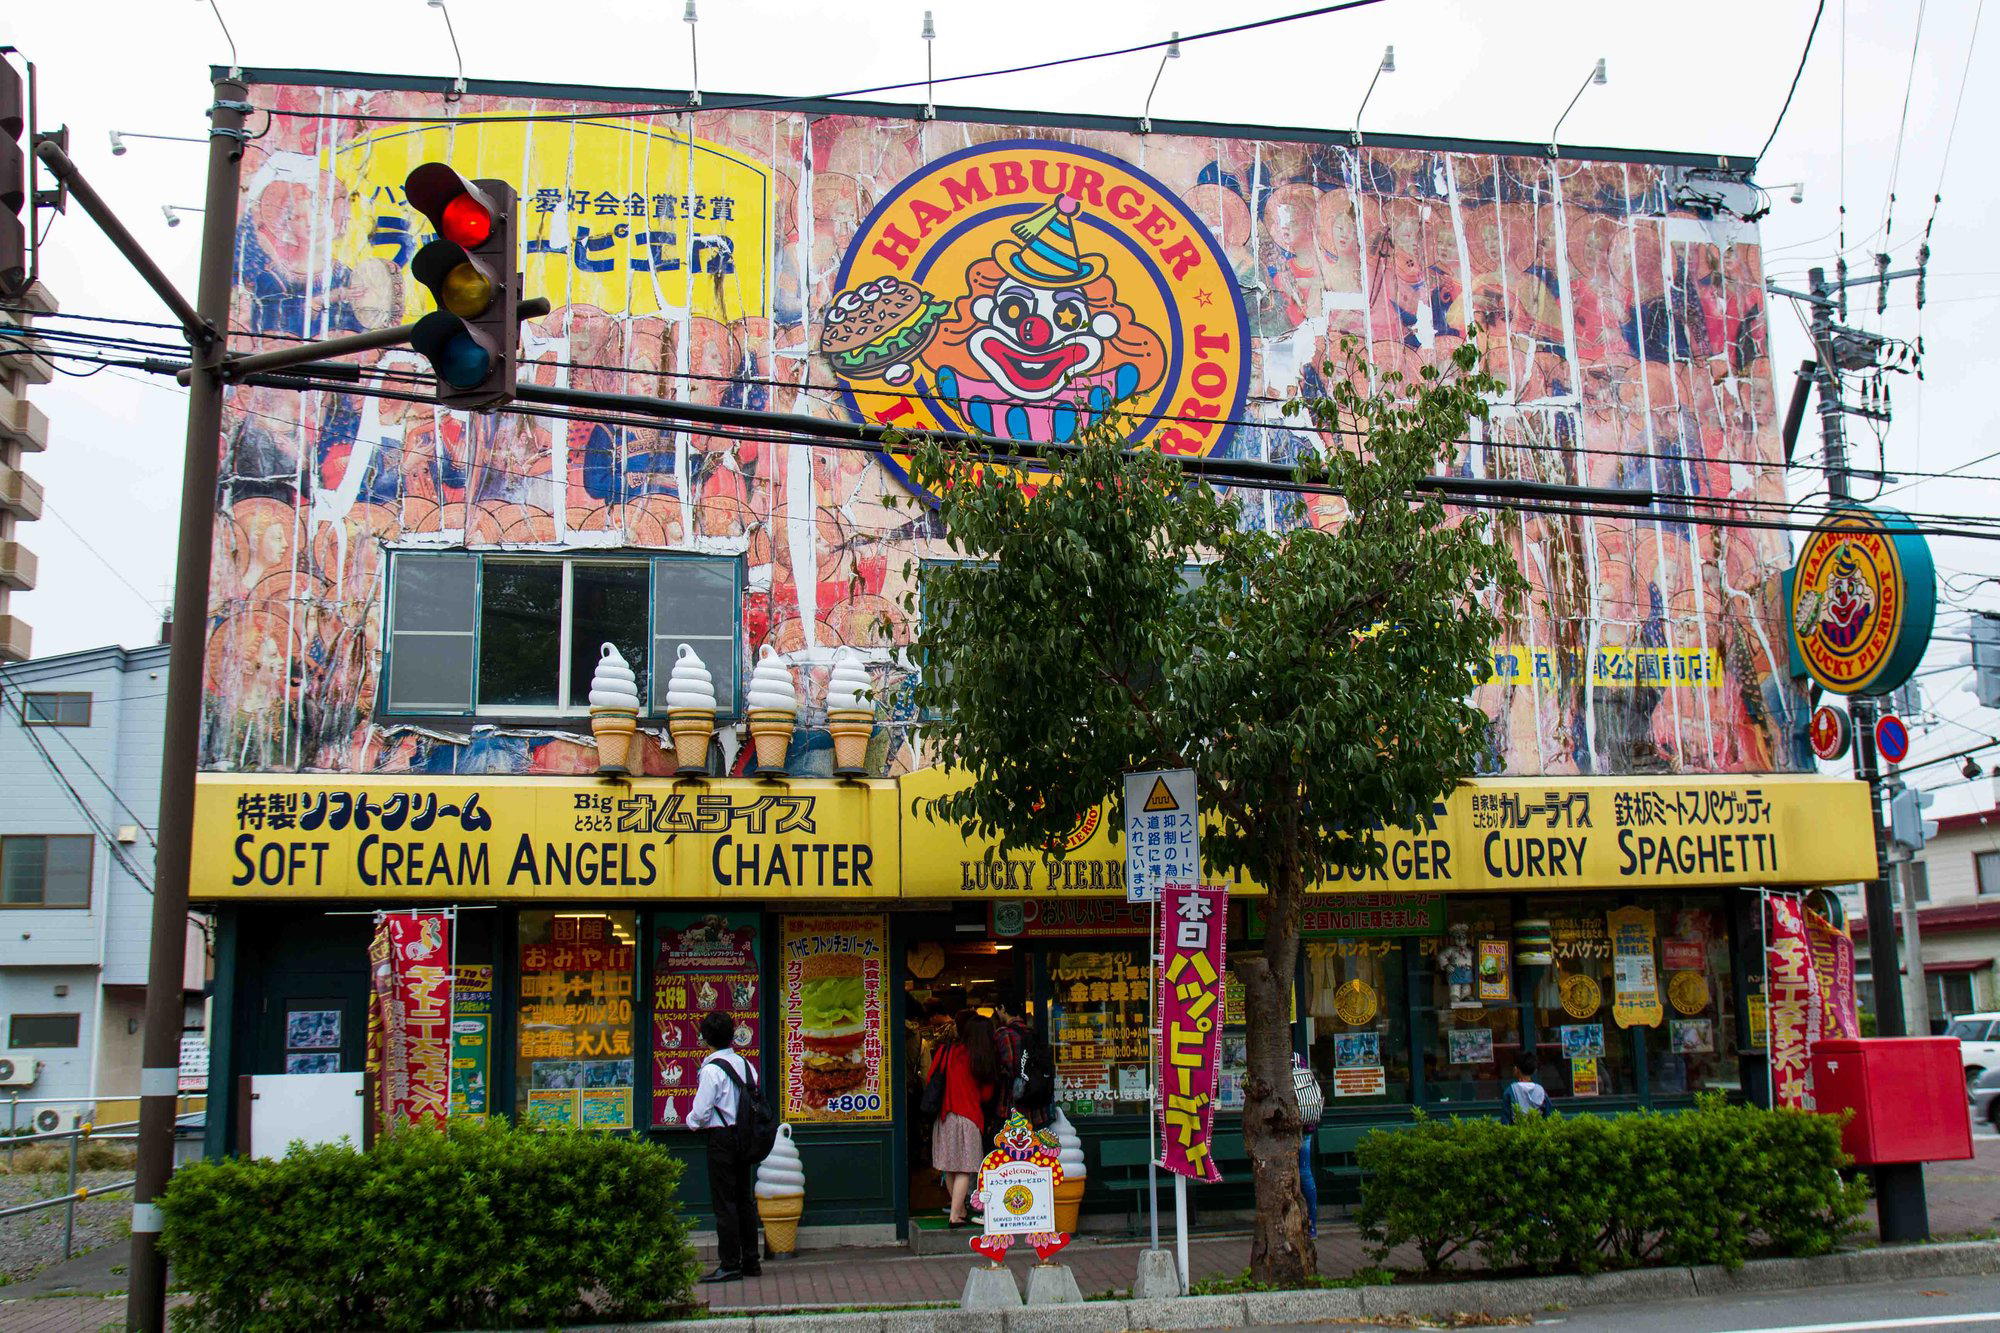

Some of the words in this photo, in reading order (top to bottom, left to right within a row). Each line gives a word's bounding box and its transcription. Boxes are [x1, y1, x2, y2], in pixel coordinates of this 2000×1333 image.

[872, 159, 1202, 282] HAMBURGER
[1808, 636, 1854, 677] LUCKY
[1858, 571, 1893, 671] PIERROT
[1531, 653, 1712, 681] 五郭公園前店
[237, 791, 492, 832] 特製ソフトクリーム
[573, 793, 614, 813] Big
[617, 793, 816, 835] オムライス
[1472, 794, 1499, 811] 自家製
[1472, 812, 1499, 829] こだわり
[1499, 792, 1593, 829] カレーライス
[1613, 789, 1772, 828] 鉄板ミートスパゲッティ
[574, 814, 613, 832] とろとろ
[1062, 803, 1099, 849] IERRO
[232, 833, 330, 887] SOFT
[357, 833, 490, 887] CREAM
[711, 834, 874, 887] CHATTER
[1131, 817, 1146, 898] 入れています
[1179, 813, 1194, 877] スピード
[1483, 830, 1588, 878] CURRY
[1617, 828, 1778, 876] SPAGHETTI
[960, 859, 1037, 891] LUCKY
[1047, 859, 1127, 890] PIERR
[1176, 892, 1212, 949] 本日
[525, 947, 631, 968] おみやげ
[787, 937, 810, 958] THE
[575, 1030, 631, 1056] 大人気
[828, 1094, 881, 1112] ¥800
[999, 1167, 1038, 1179] Welcome
